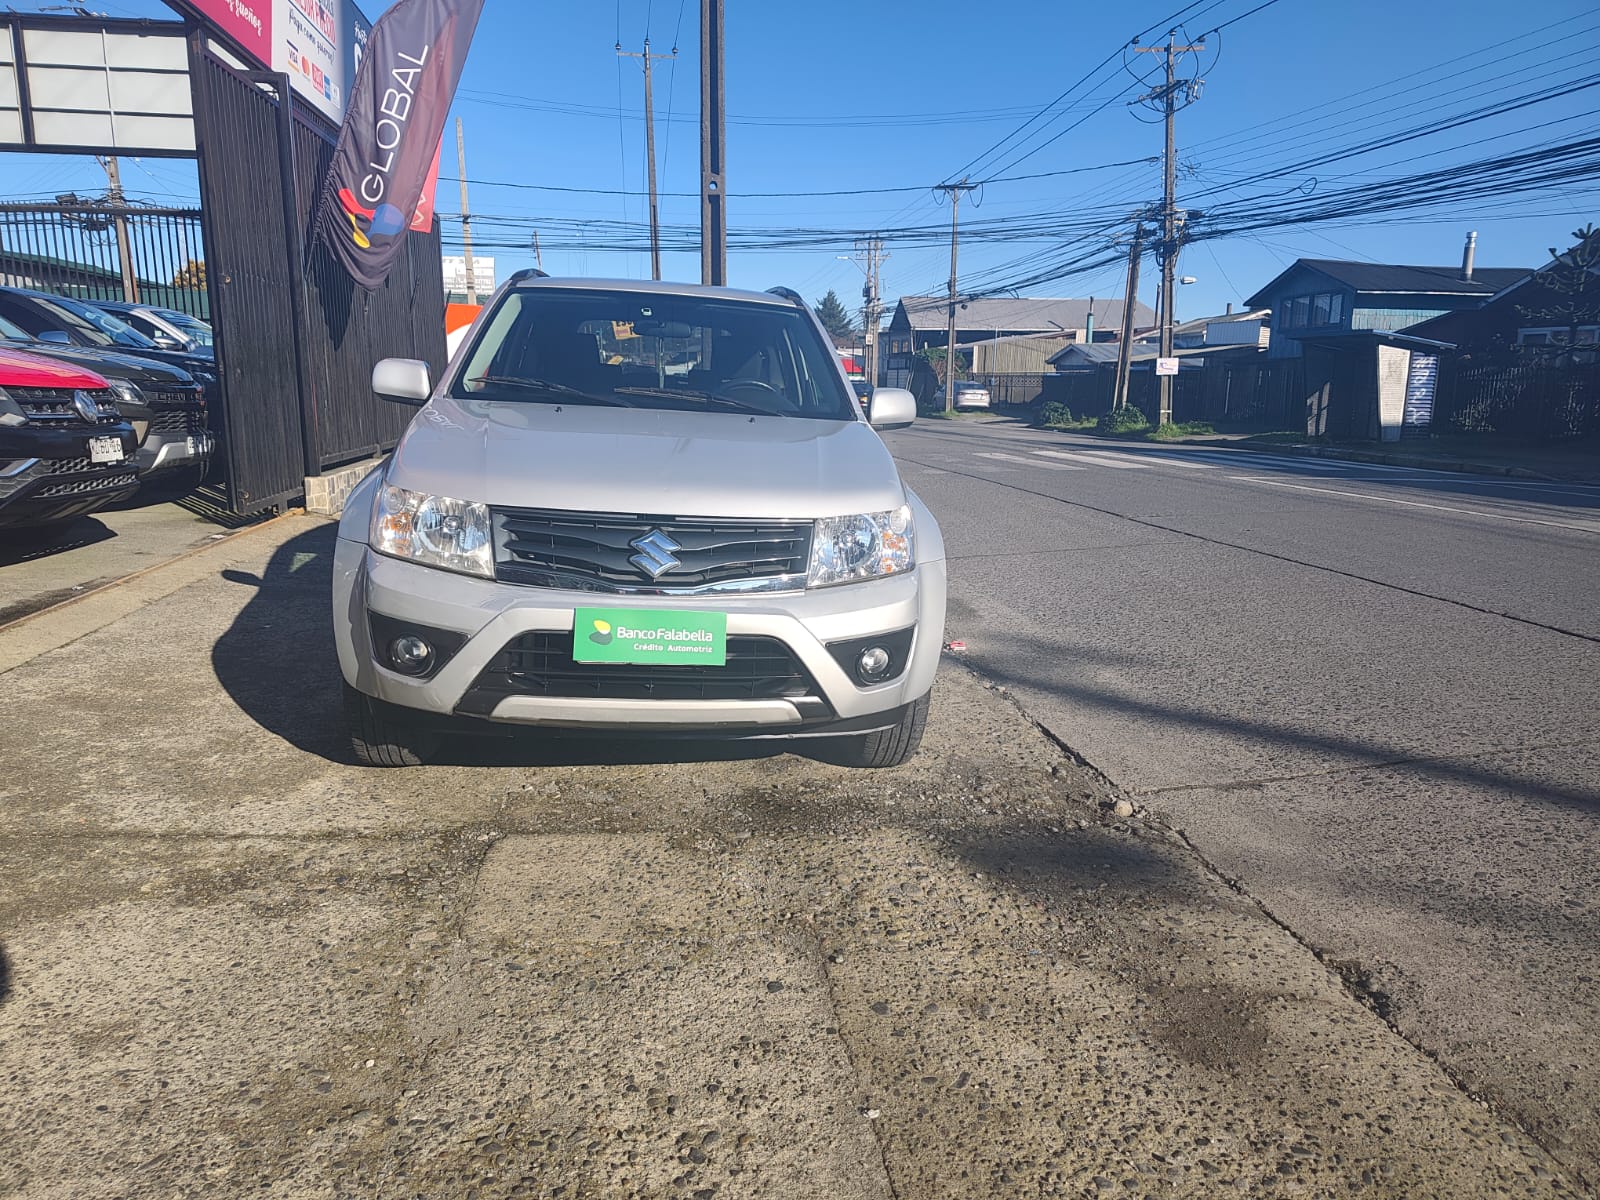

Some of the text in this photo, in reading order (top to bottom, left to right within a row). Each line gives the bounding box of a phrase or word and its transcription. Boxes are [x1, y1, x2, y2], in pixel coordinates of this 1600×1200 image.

[288, 48, 298, 64] VISA
[361, 45, 429, 202] GLOBAL
[616, 626, 713, 642] Banco Falabella
[633, 643, 713, 653] Crédito Automotriz
